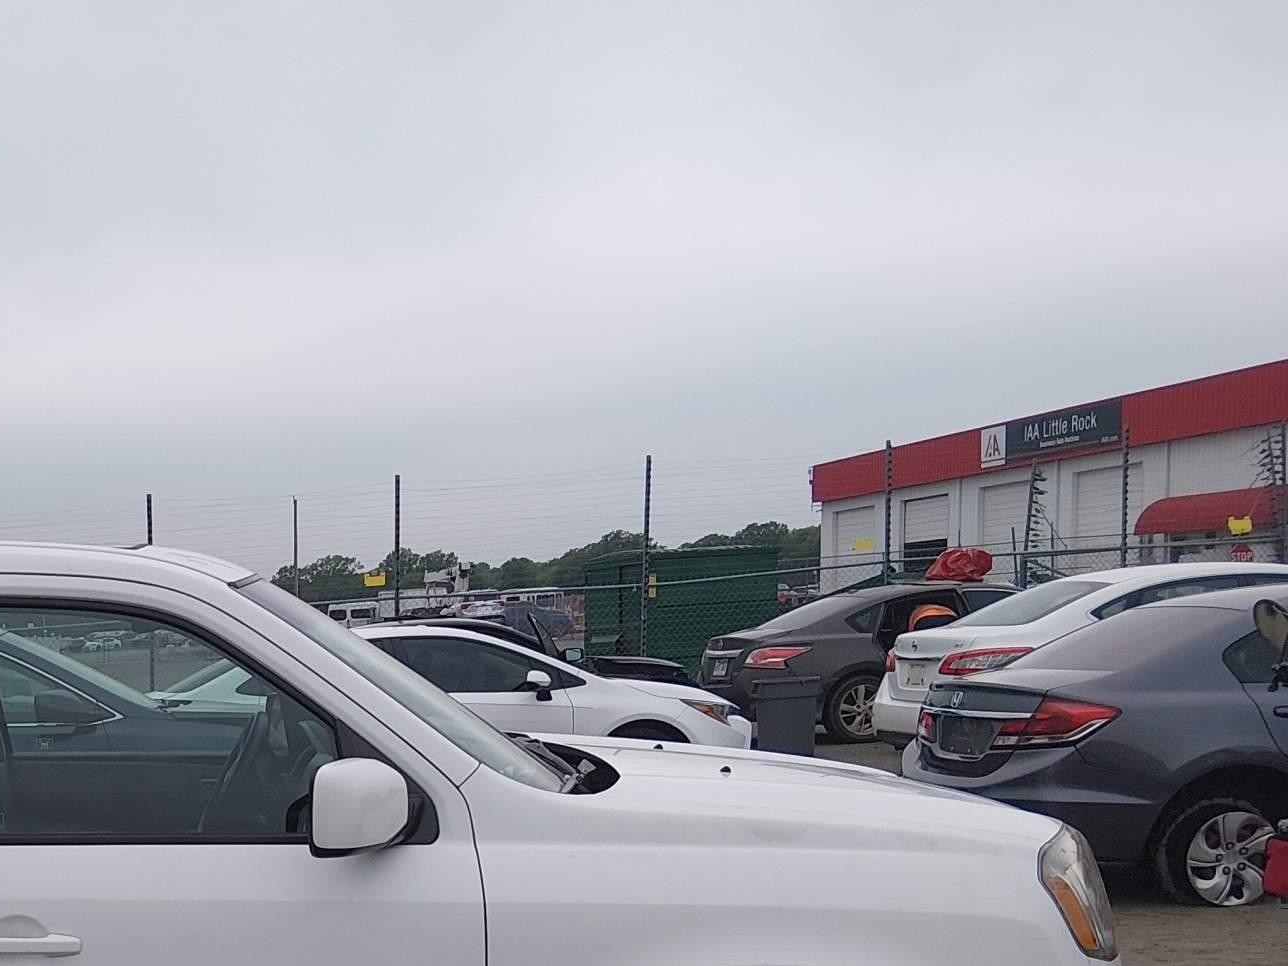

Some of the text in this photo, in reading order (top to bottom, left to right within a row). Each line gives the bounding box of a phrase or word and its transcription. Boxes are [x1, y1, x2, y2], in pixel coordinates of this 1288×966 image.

[1024, 423, 1040, 442] IAA
[1043, 417, 1068, 437] Little
[1071, 410, 1097, 432] Rock
[1231, 551, 1253, 561] STOP
